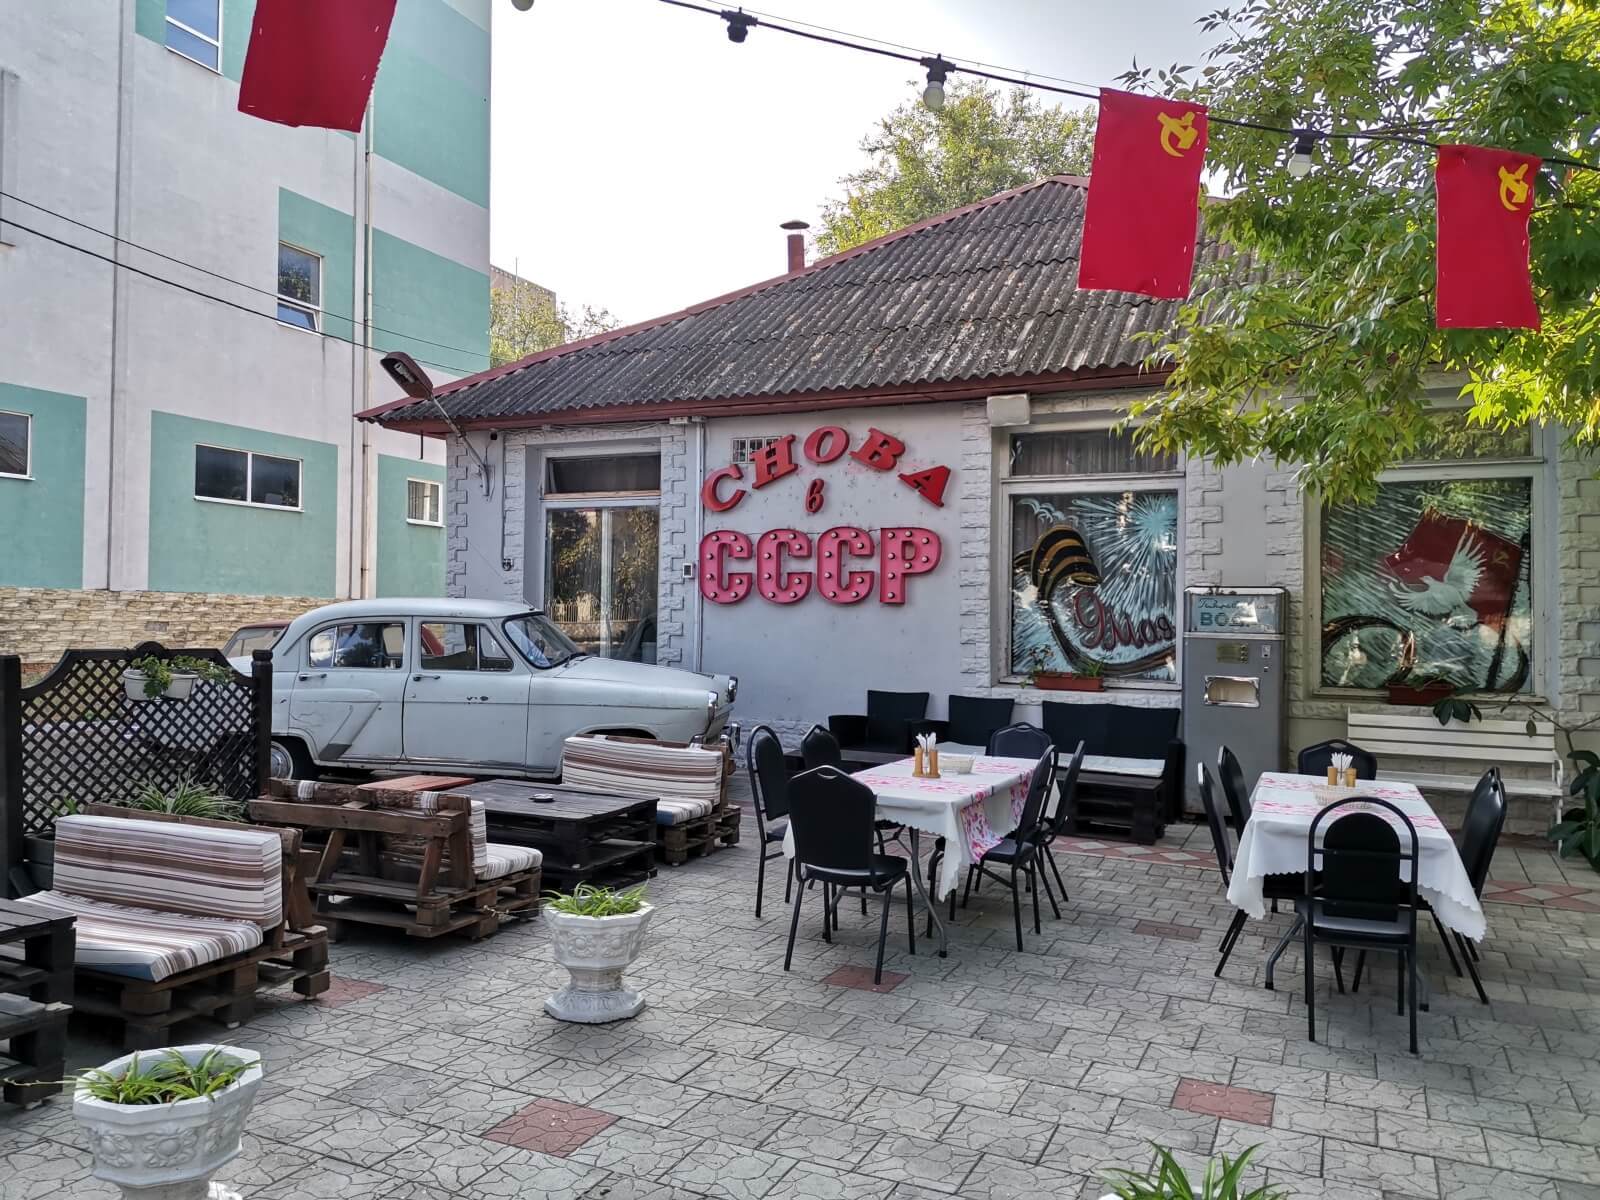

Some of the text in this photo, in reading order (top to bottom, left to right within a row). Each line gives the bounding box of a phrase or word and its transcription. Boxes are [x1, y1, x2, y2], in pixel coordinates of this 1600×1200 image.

[701, 425, 951, 512] СНОВА
[700, 526, 942, 605] СССР
[1074, 591, 1105, 649] 9
